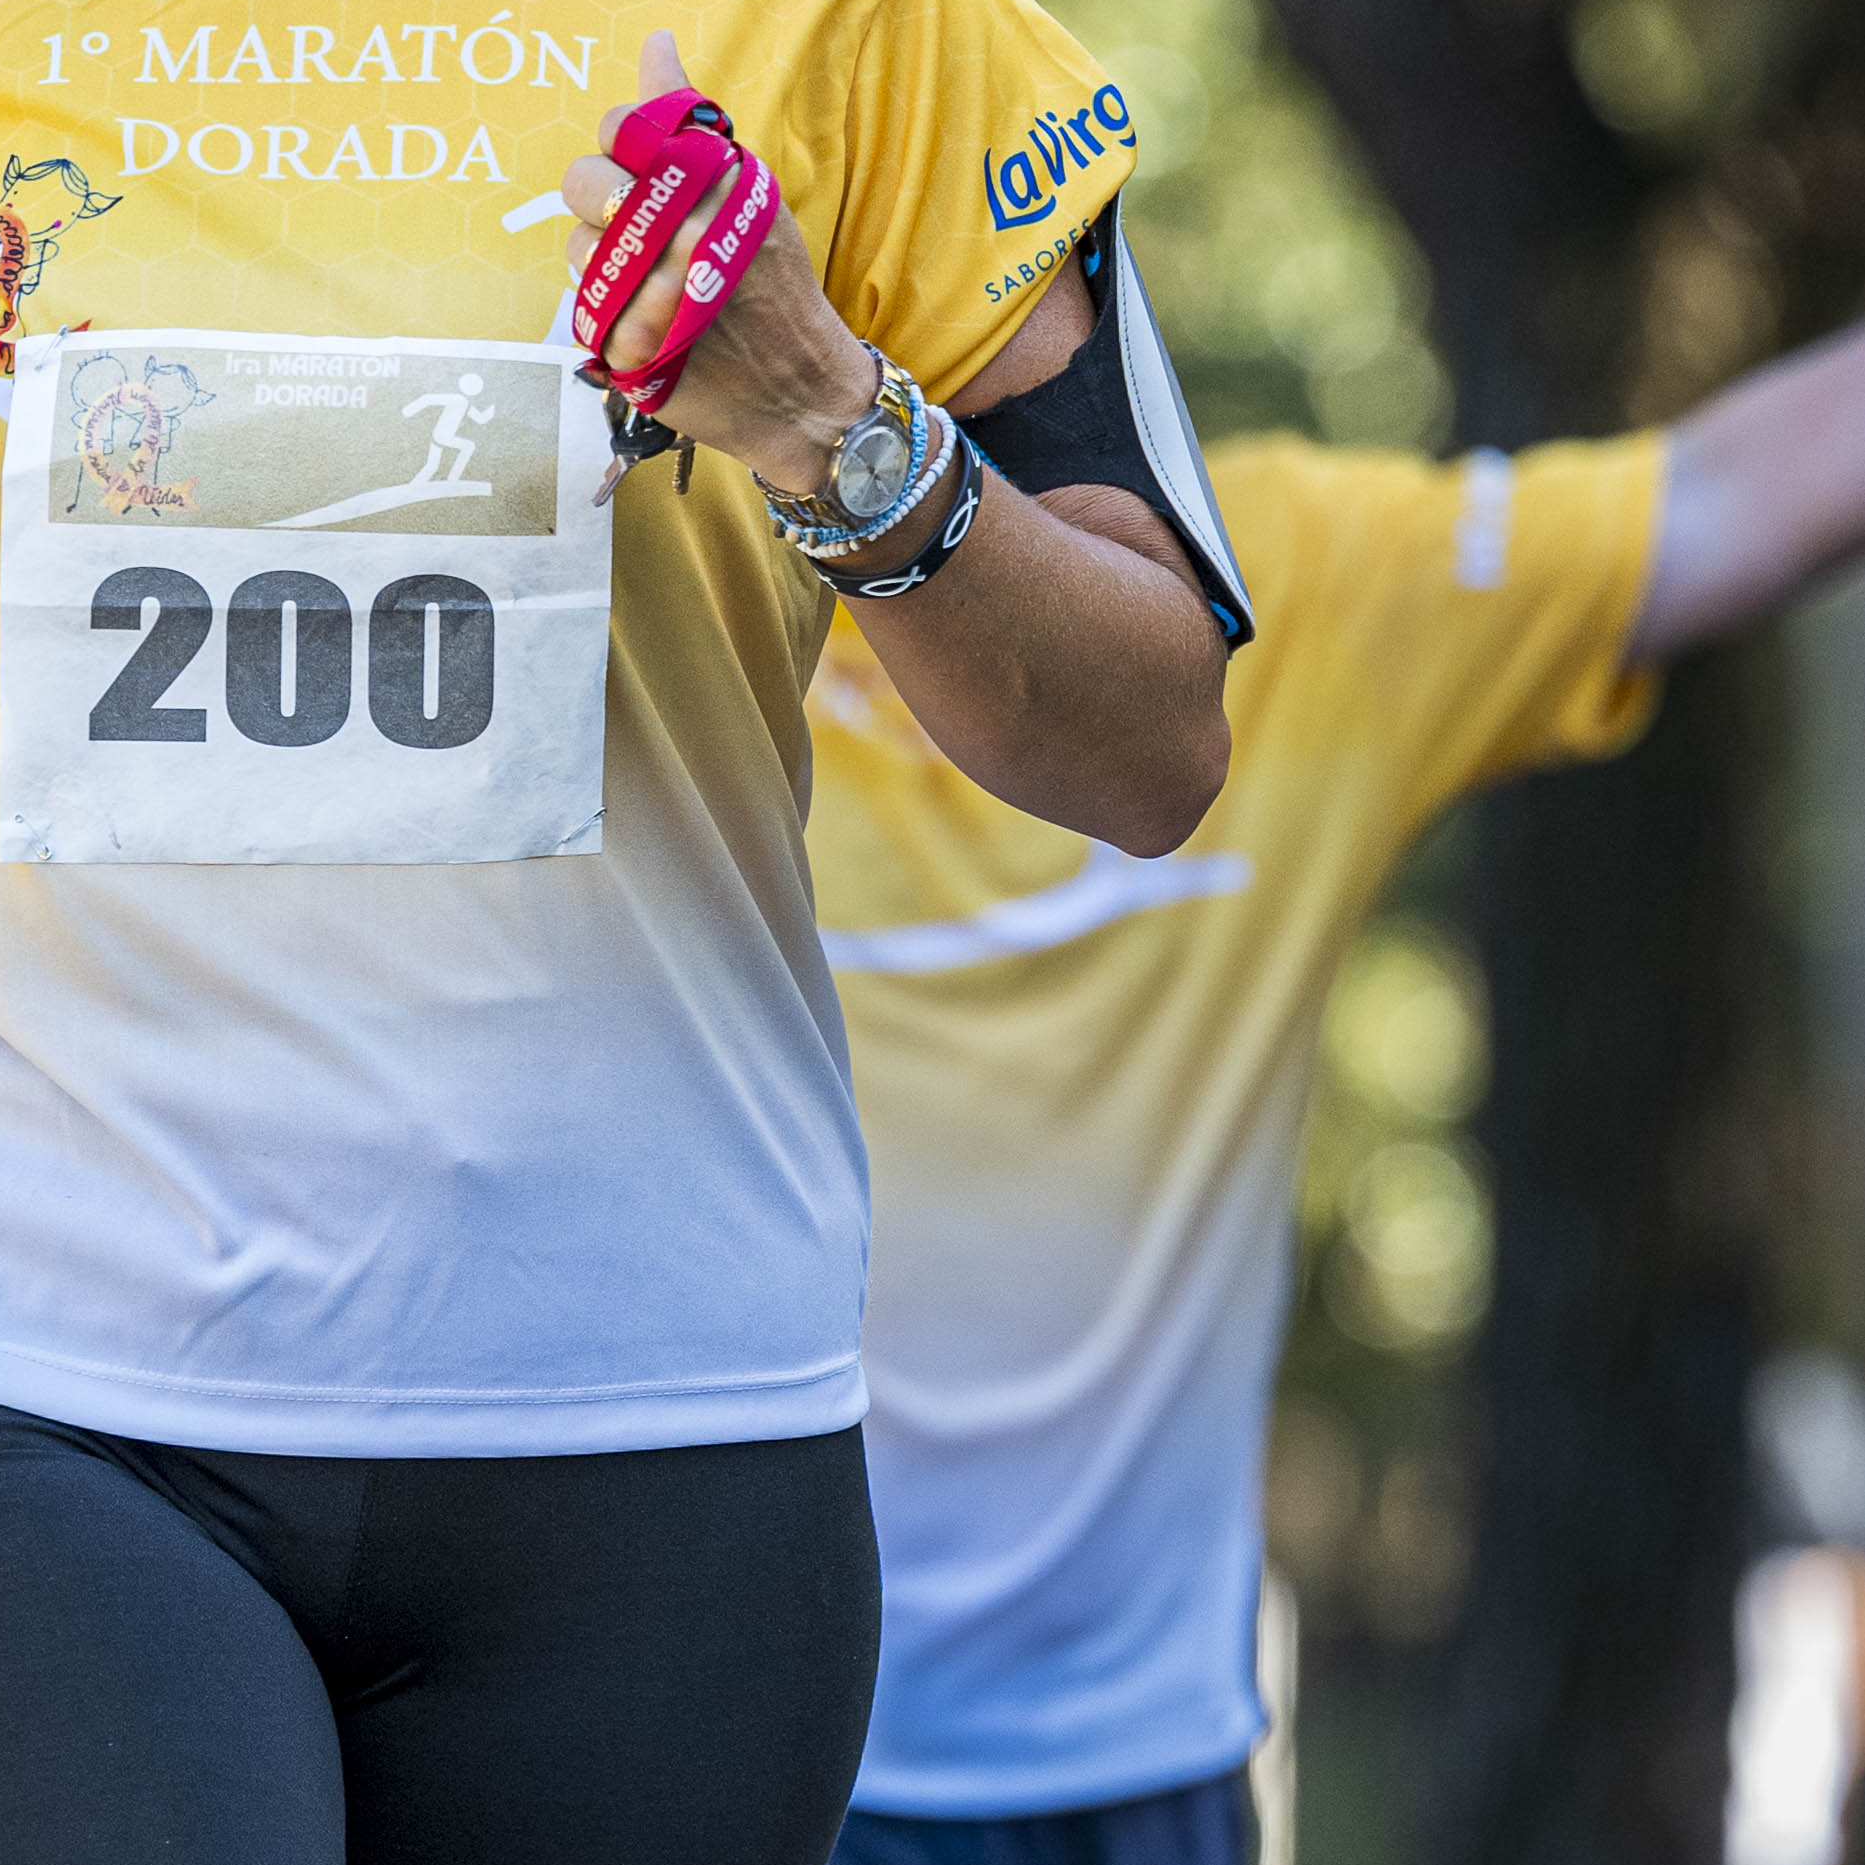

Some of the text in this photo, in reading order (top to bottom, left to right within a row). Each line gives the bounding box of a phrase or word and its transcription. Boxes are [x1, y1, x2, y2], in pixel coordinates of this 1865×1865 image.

[135, 8, 599, 91] MARATÓN
[115, 116, 511, 183] DORADA
[582, 164, 687, 310] la segunda
[708, 231, 741, 265] la
[253, 383, 369, 410] DORADA
[88, 565, 496, 750] 200
